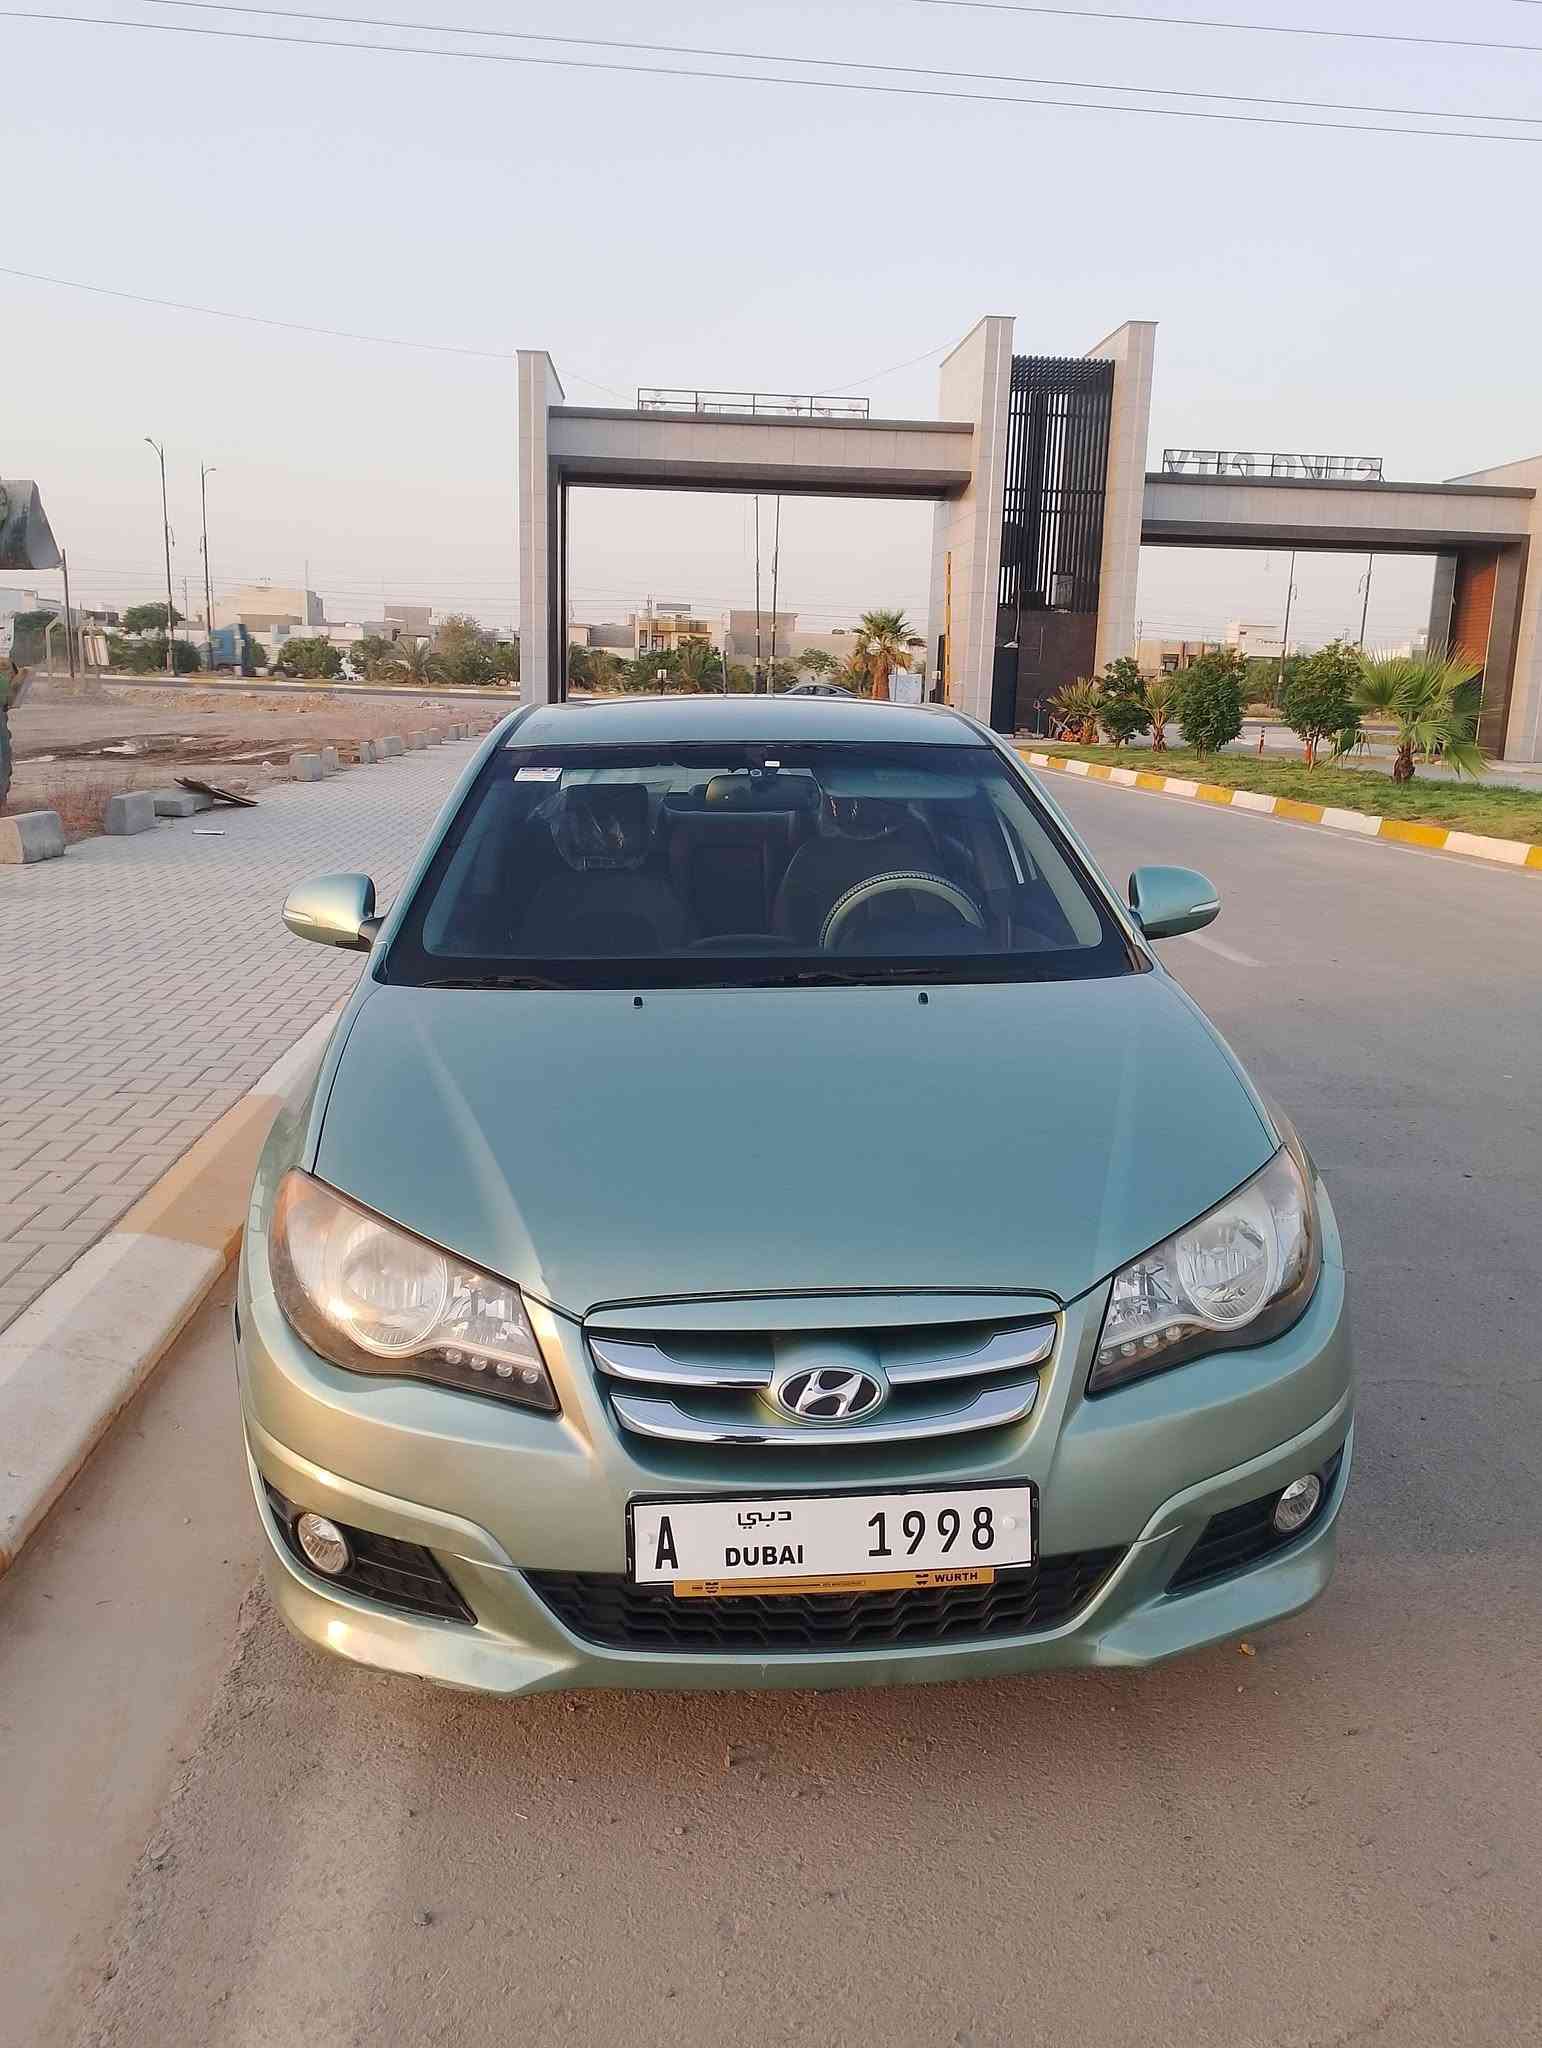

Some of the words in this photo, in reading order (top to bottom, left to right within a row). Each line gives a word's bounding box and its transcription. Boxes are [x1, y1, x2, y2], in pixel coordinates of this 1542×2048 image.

[737, 1510, 792, 1530] دبي
[867, 1506, 995, 1557] 1998
[654, 1515, 679, 1570] A
[725, 1544, 804, 1567] DUBAI
